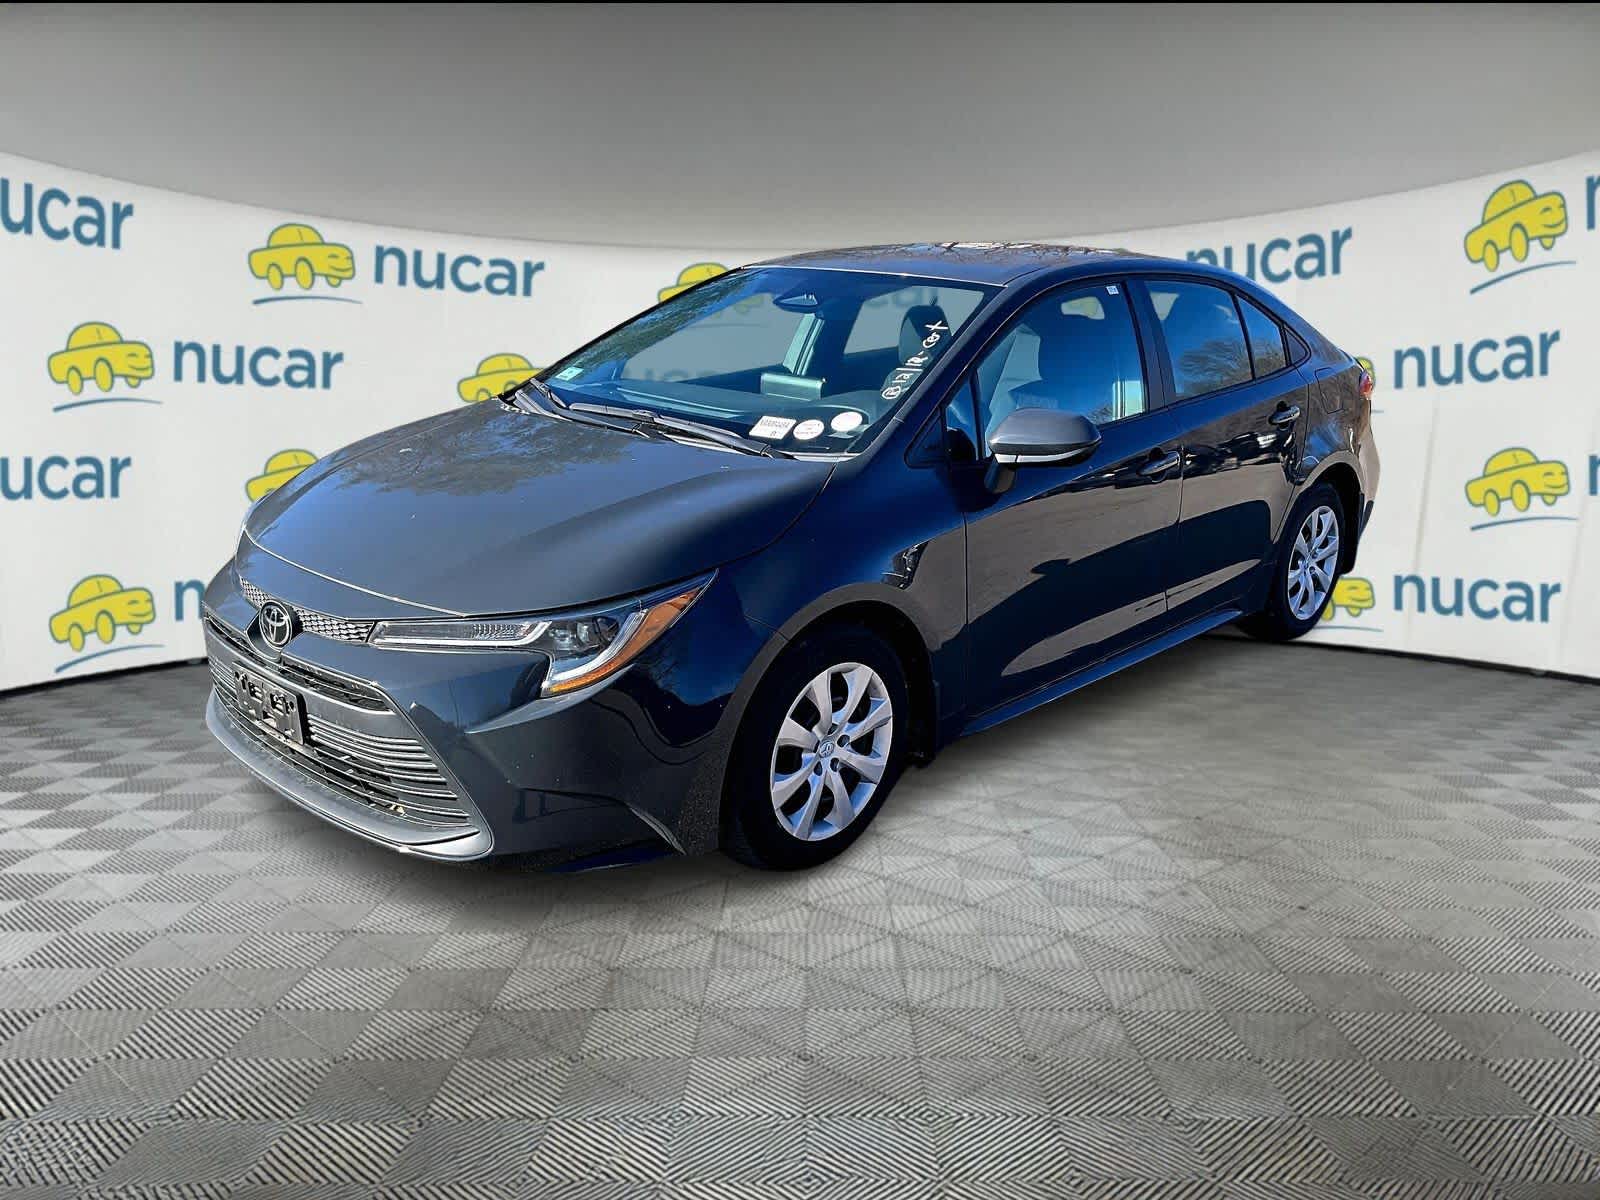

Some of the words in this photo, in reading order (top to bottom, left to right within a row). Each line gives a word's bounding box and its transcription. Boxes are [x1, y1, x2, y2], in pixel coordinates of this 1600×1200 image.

[374, 245, 545, 297] nucar
[173, 340, 344, 390] nucar
[1393, 329, 1561, 389] nucar
[1393, 574, 1562, 623] nucar
